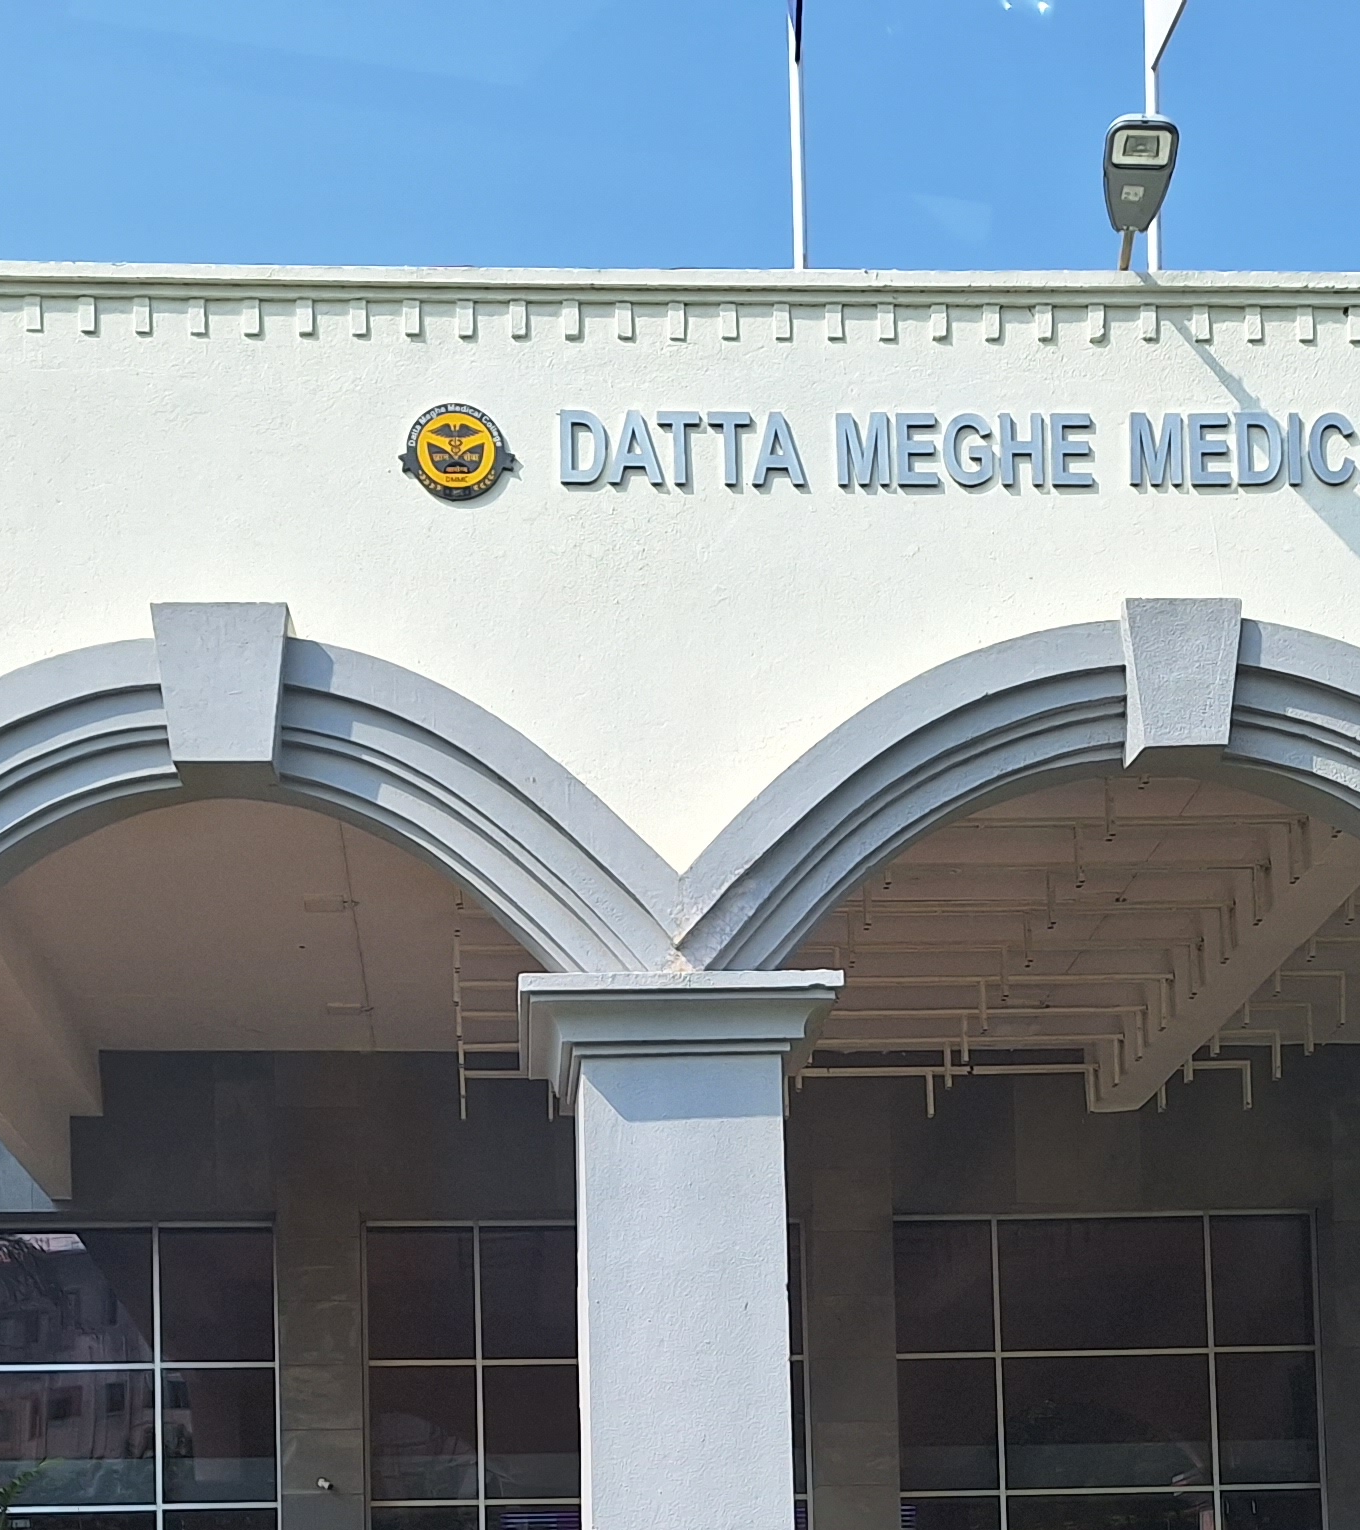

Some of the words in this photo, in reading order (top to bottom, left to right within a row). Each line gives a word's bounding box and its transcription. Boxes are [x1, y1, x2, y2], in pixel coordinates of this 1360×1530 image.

[447, 404, 482, 419] Medical
[559, 409, 806, 486] DATTA
[835, 411, 1094, 487] MEGHE
